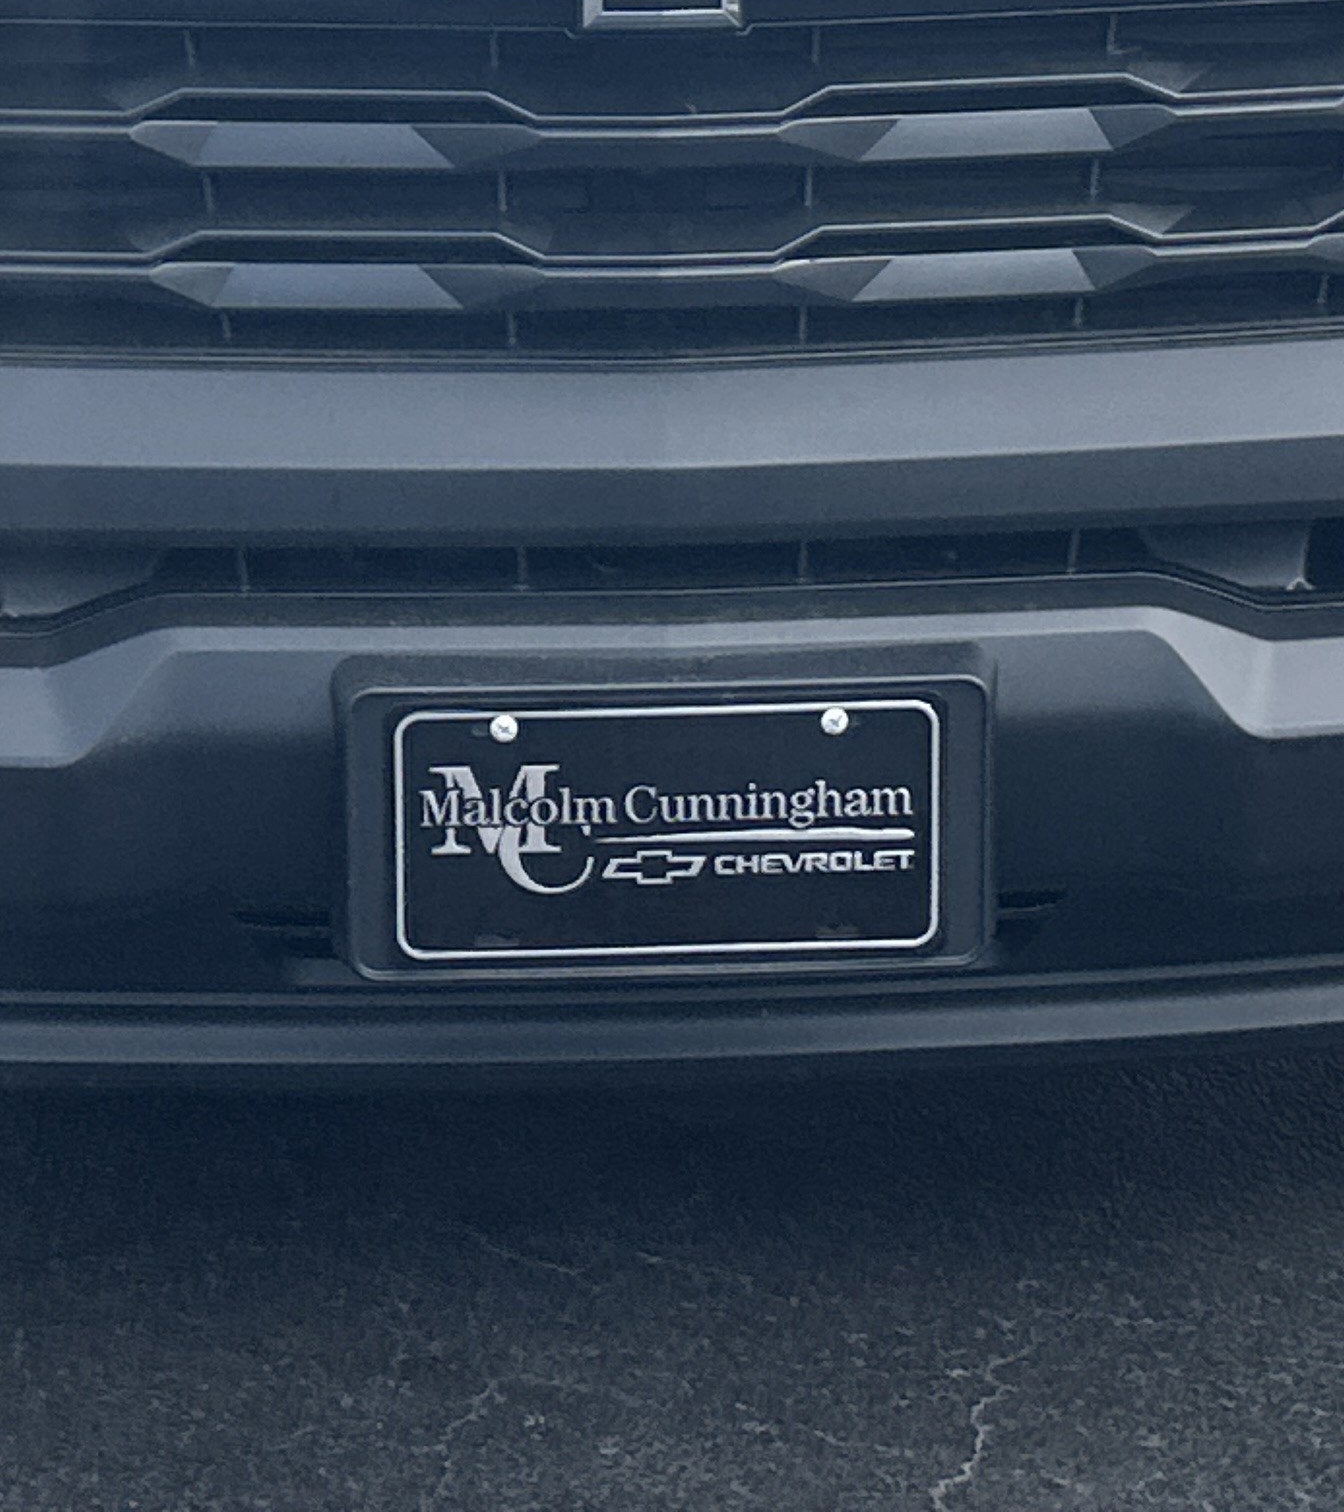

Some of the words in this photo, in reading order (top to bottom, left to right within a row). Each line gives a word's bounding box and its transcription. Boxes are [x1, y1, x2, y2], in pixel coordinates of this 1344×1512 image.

[418, 787, 618, 828] Malcolm
[624, 778, 914, 829] Cunningham
[713, 849, 916, 876] CHEVROLET
